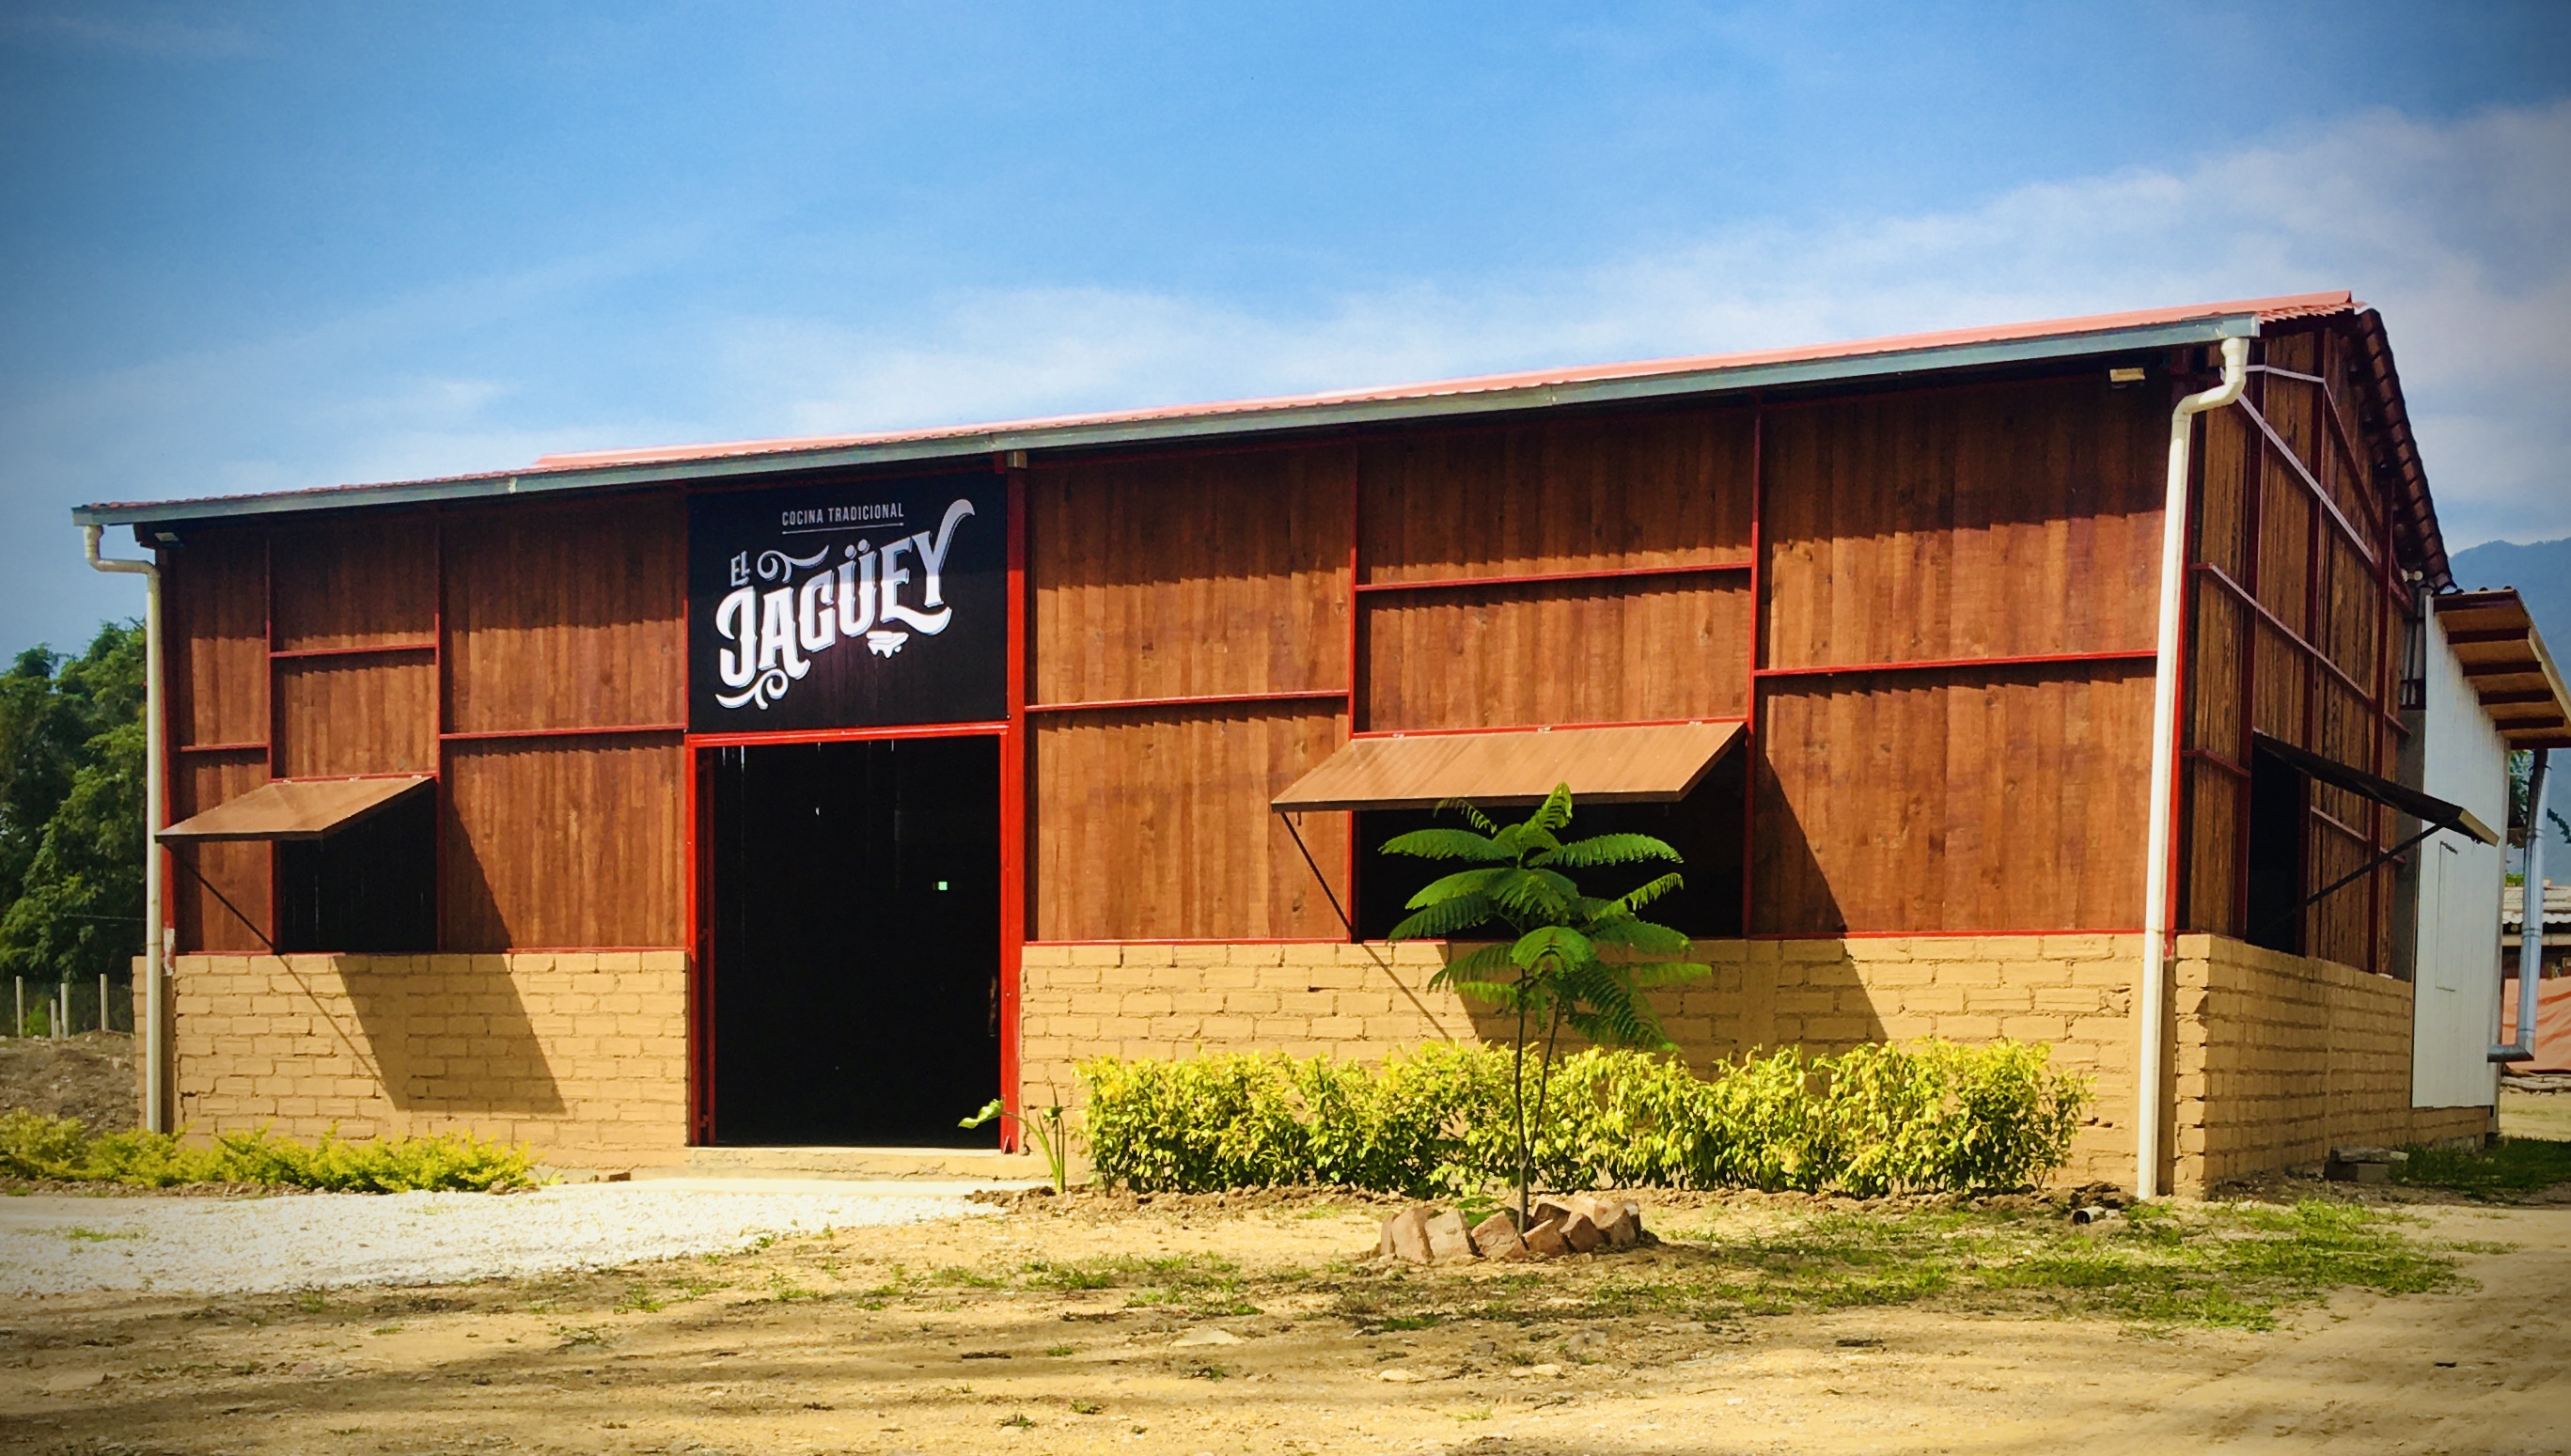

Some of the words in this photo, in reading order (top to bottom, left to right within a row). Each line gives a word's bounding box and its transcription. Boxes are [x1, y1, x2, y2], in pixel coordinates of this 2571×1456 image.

[781, 508, 823, 526] COCINA
[827, 502, 904, 523] TRADICIONAL
[730, 550, 750, 587] EL
[715, 498, 976, 689] JAGÜEY
